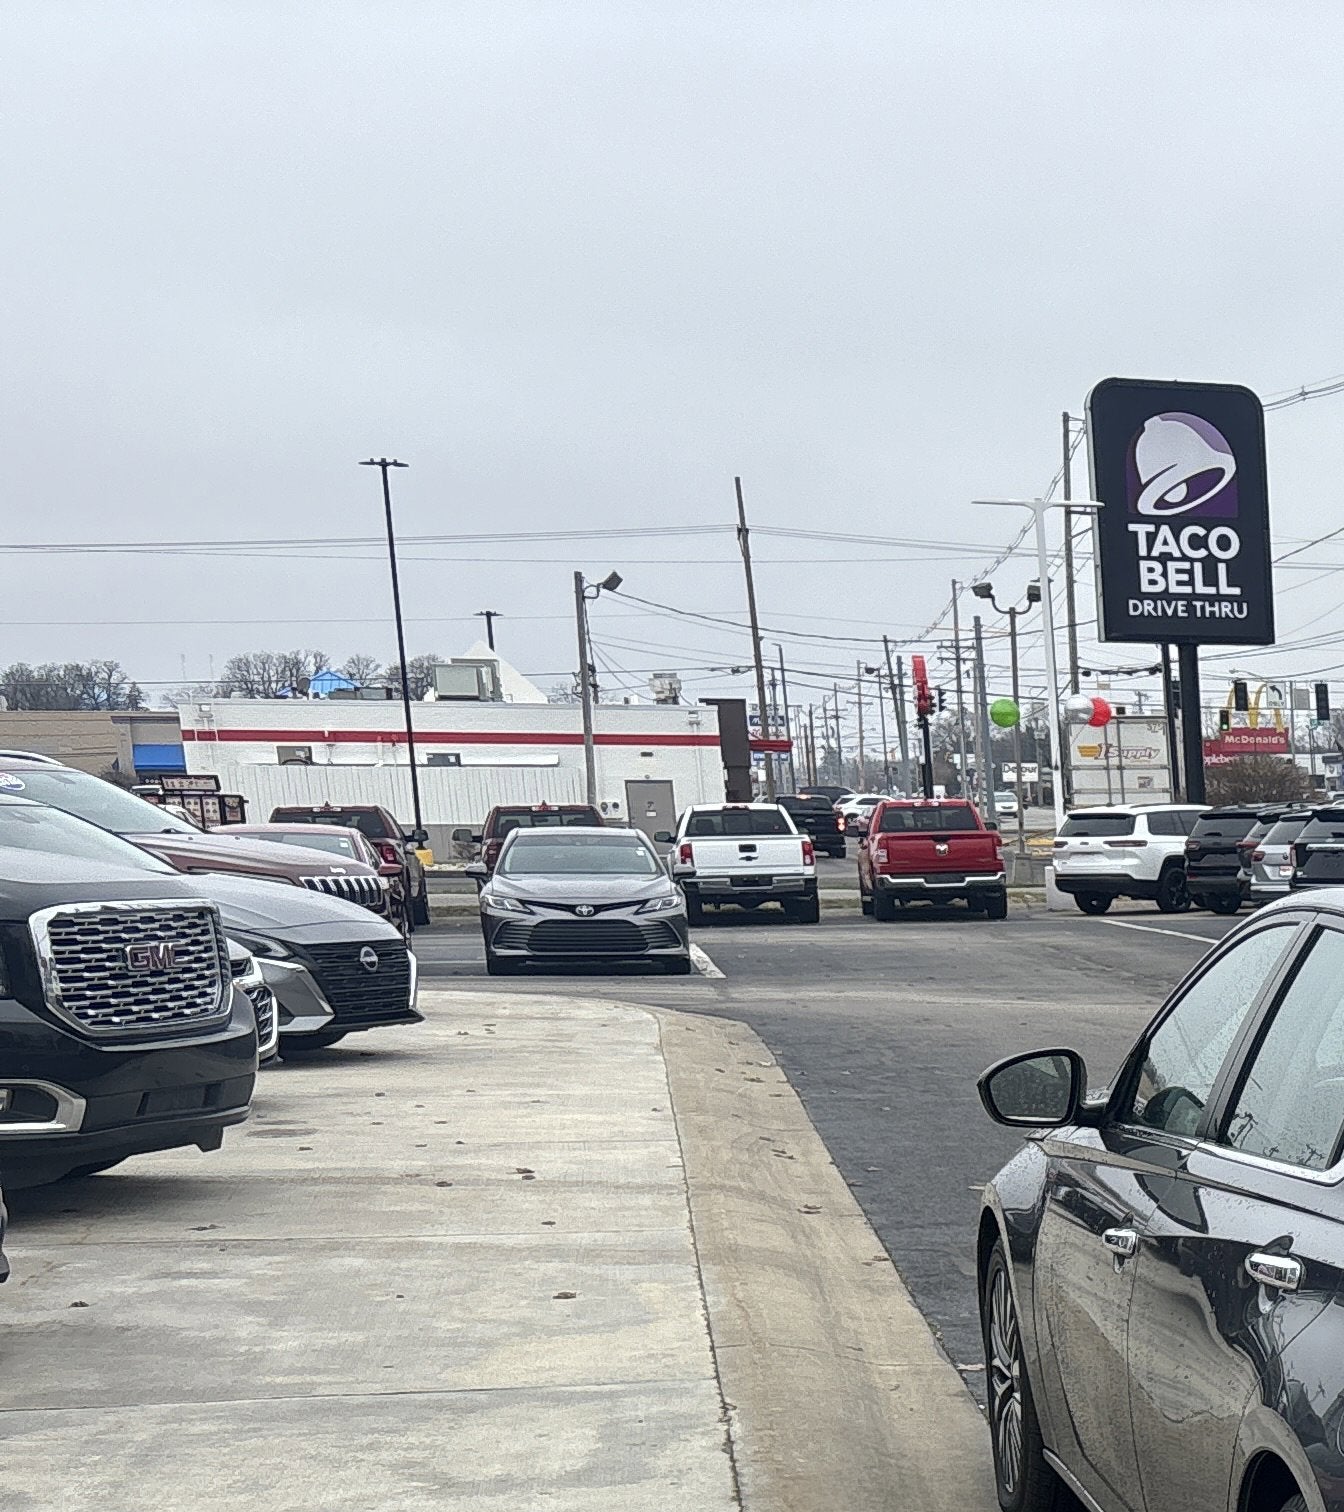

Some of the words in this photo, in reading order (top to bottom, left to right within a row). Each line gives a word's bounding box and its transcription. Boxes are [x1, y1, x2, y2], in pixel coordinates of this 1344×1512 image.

[1127, 523, 1240, 560] TACO
[1138, 560, 1242, 595] BELL
[1128, 599, 1189, 617] DRIVE
[1192, 601, 1248, 619] THRU
[1224, 735, 1285, 744] McDonald's
[127, 943, 185, 970] GMC
